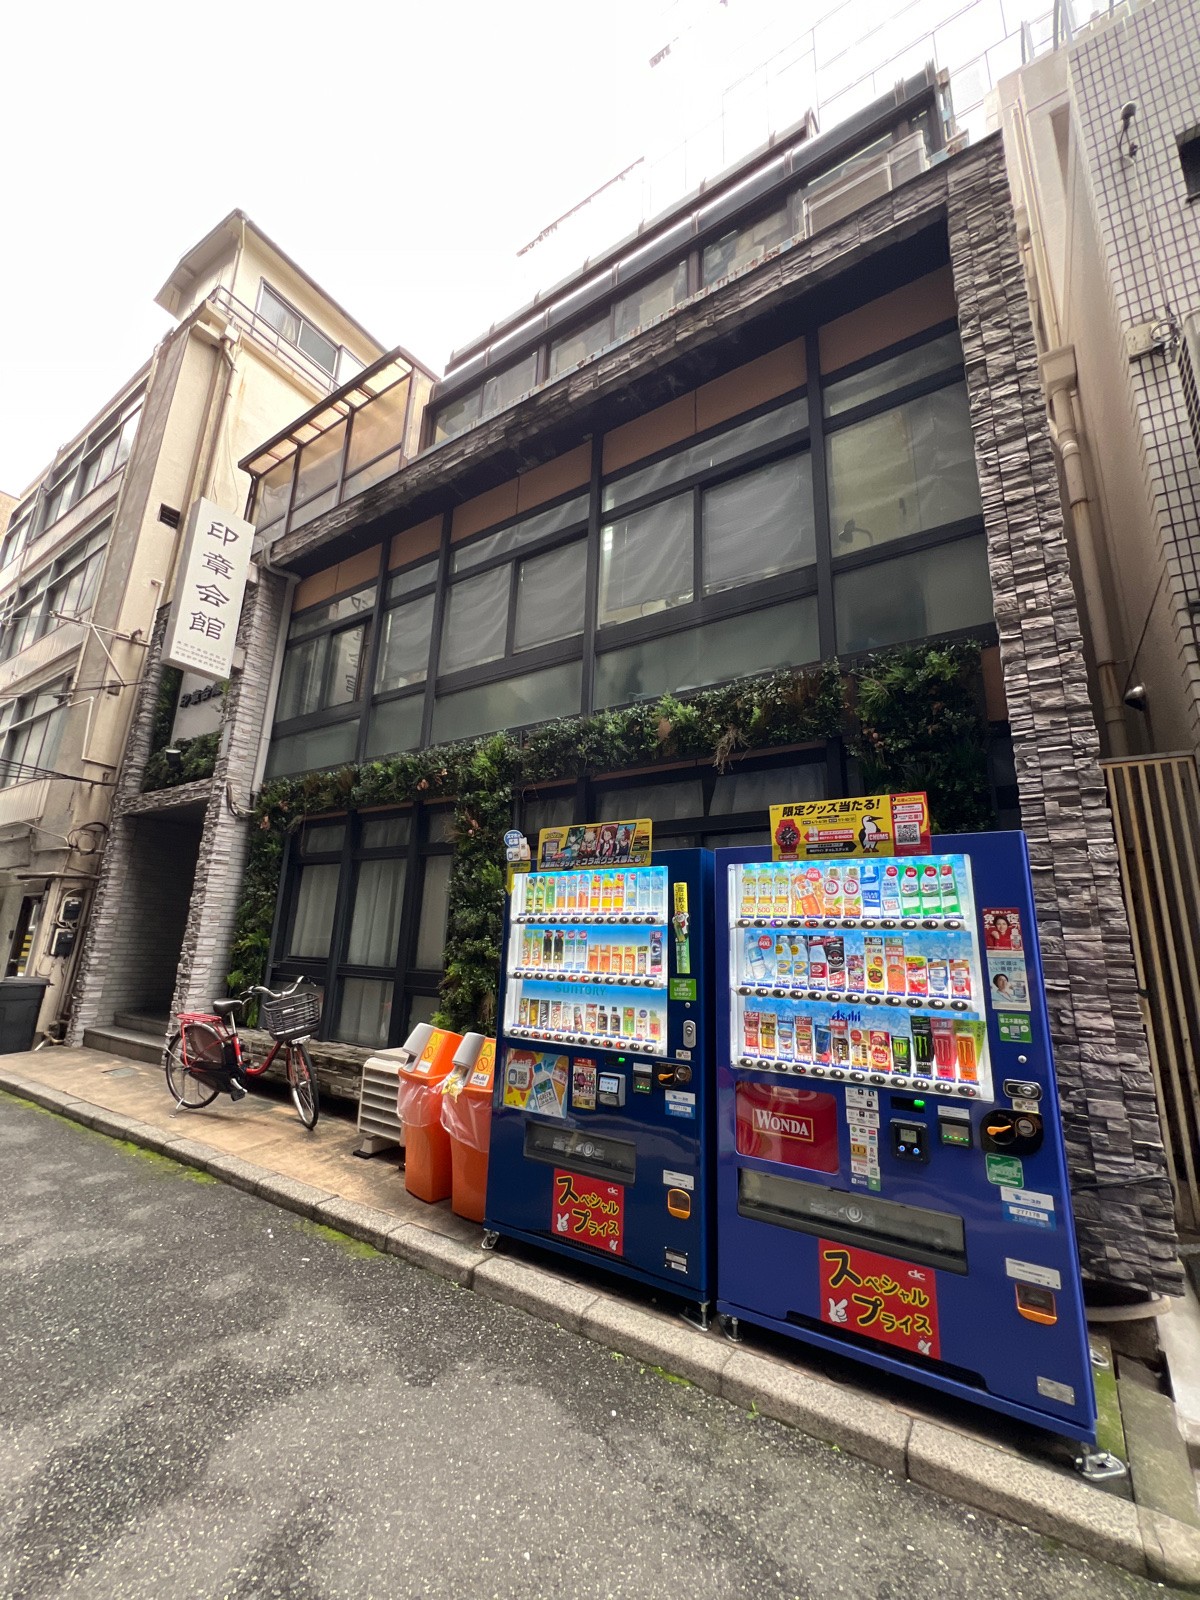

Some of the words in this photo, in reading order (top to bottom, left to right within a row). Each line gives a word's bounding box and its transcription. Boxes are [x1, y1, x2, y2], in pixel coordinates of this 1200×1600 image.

[189, 521, 240, 640] 印章会館
[869, 833, 889, 841] CHUMS
[555, 984, 606, 995] SUNTORY
[832, 1010, 861, 1022] Asahi
[755, 1109, 809, 1136] WONDA
[557, 1176, 619, 1216] スペシャル
[572, 1209, 619, 1238] プライス
[823, 1249, 930, 1308] スペシャル
[852, 1293, 932, 1336] プライス
